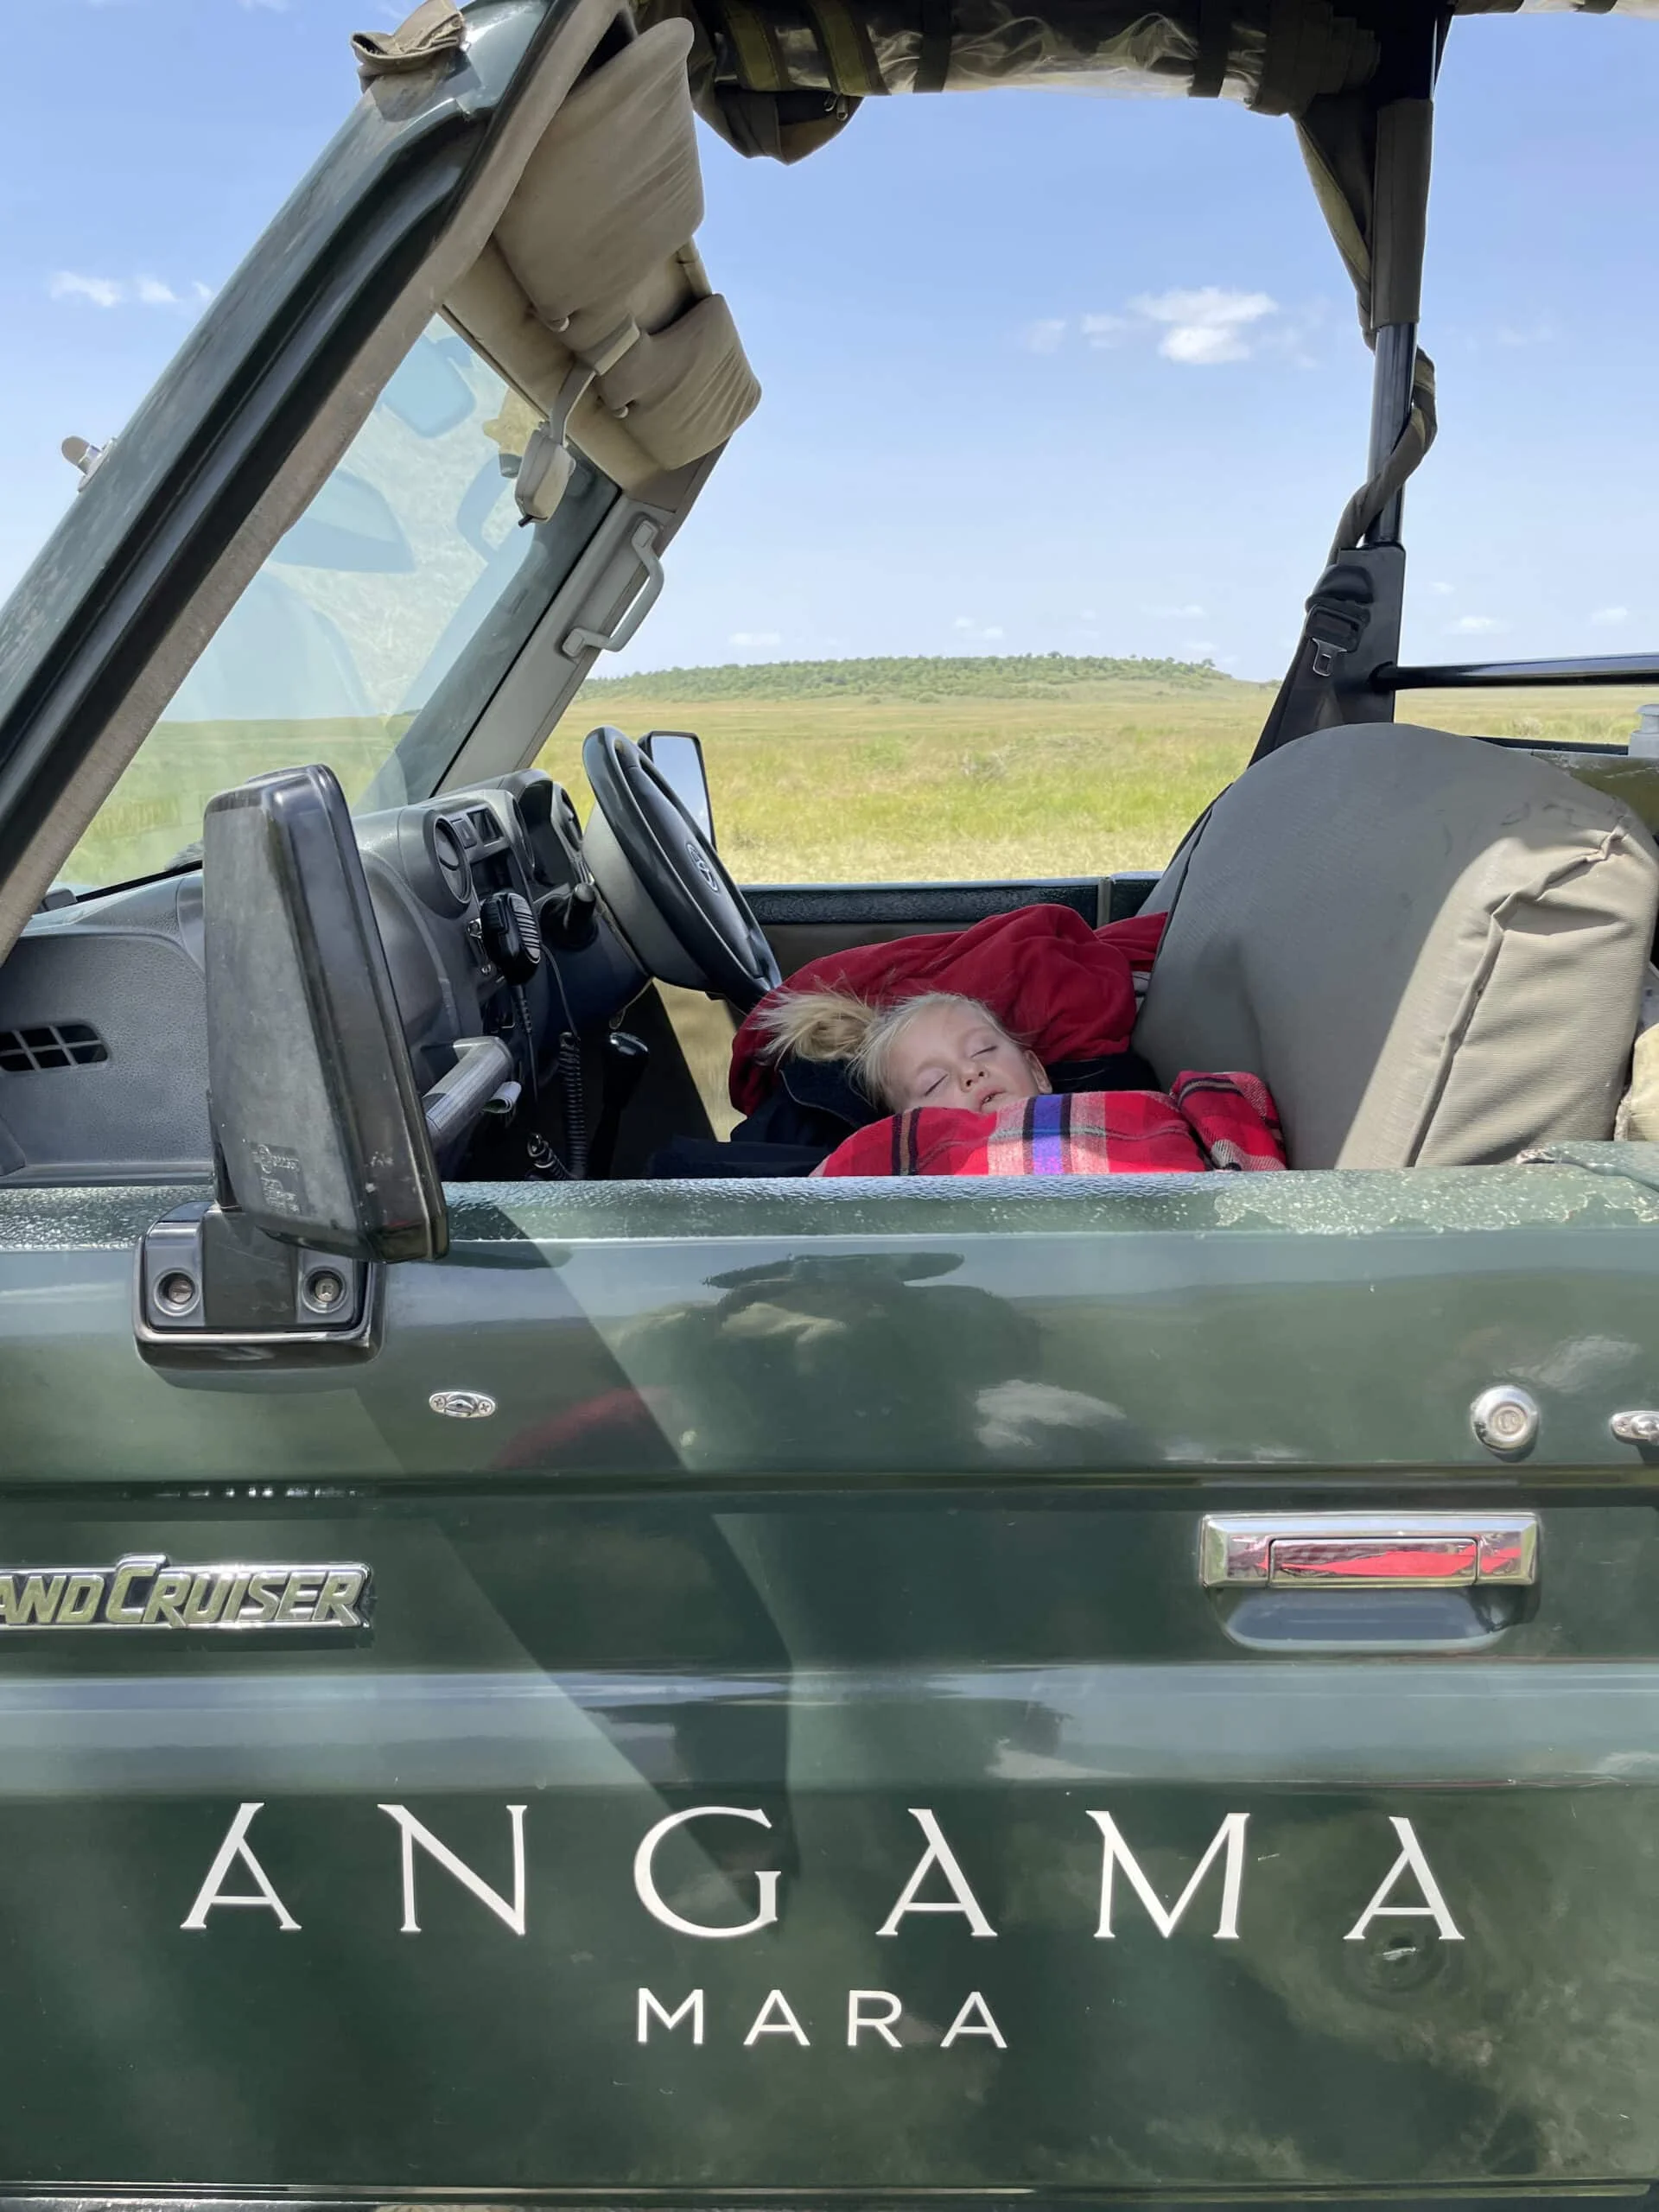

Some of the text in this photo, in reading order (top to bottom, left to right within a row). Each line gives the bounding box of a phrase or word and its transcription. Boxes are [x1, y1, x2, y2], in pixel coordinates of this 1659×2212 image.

[105, 1562, 364, 1628] CRUISER
[180, 1802, 1466, 1941] ANGAMA
[637, 1986, 1008, 2049] MARA
